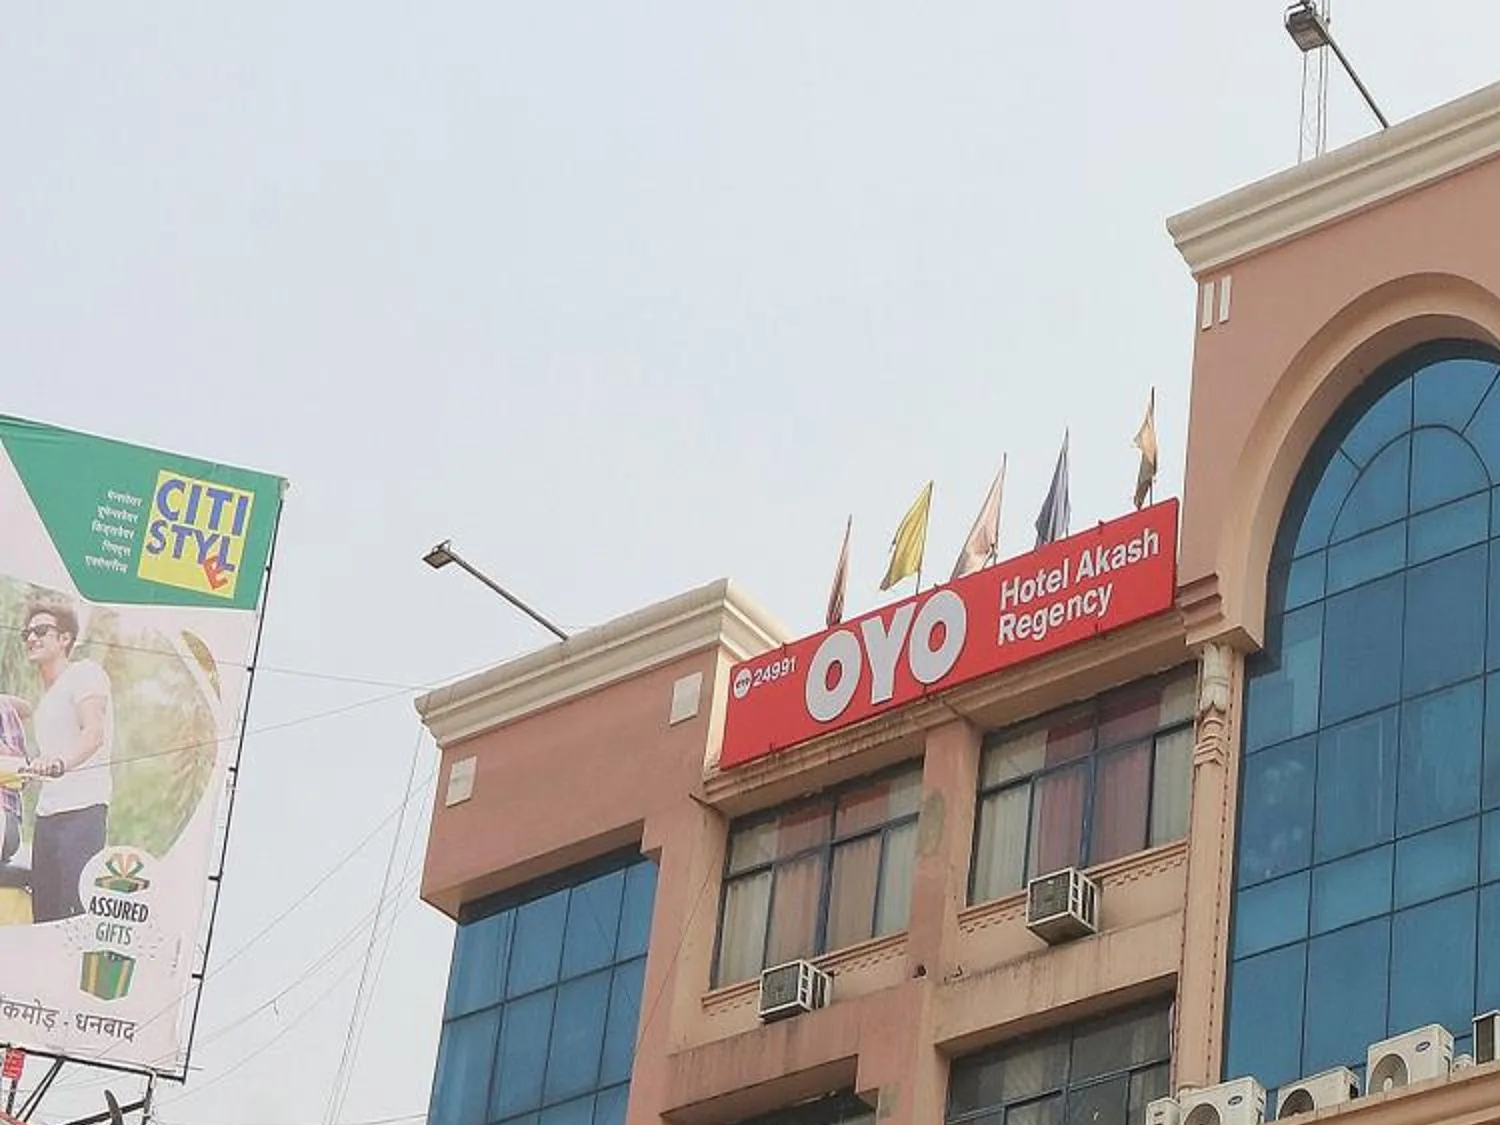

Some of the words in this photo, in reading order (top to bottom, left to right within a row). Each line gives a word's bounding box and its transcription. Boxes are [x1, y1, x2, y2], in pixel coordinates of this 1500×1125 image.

[156, 478, 250, 537] CITI
[1000, 558, 1070, 611] Hotel
[1075, 528, 1160, 584] Akash
[997, 582, 1114, 646] Regency
[750, 656, 798, 688] 24991
[804, 589, 968, 723] OYO
[88, 895, 149, 923] ASSURED
[95, 919, 133, 946] GIFTS
